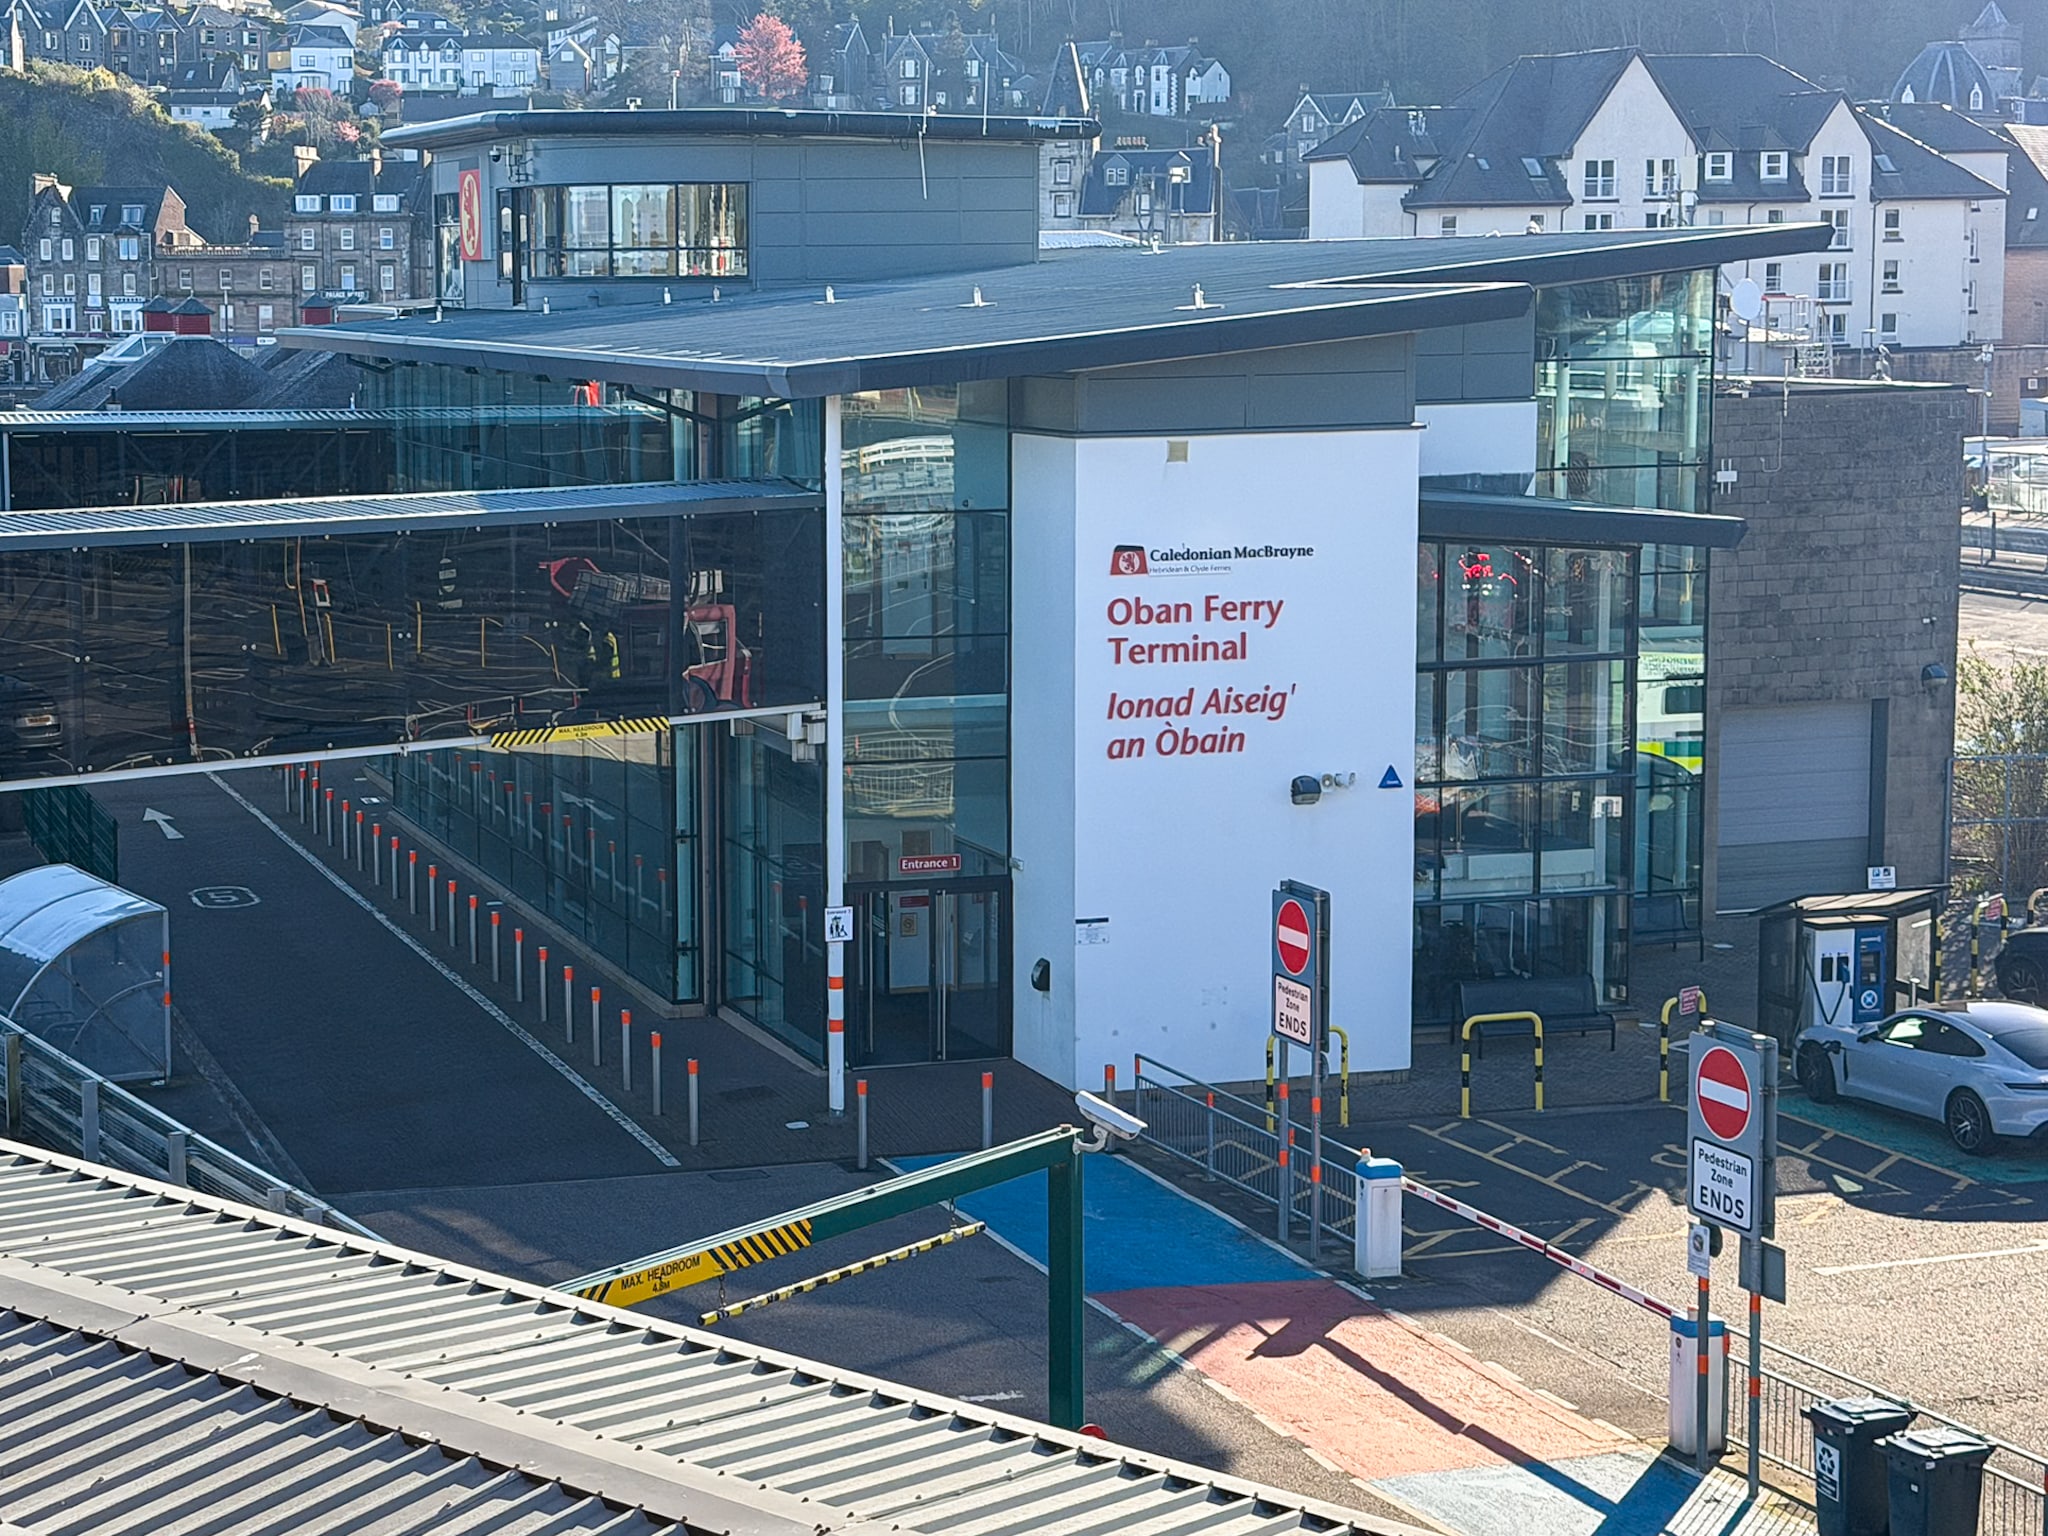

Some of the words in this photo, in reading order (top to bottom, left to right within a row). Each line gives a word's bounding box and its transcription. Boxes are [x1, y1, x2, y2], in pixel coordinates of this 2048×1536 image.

[1150, 548, 1232, 562] Caledonian
[1233, 545, 1314, 560] MacBrayne
[1150, 565, 1183, 574] Hebridean
[1190, 564, 1209, 574] Clyde
[1210, 564, 1232, 572] Ferries
[1107, 596, 1192, 626] Oban
[1204, 595, 1284, 629] Ferry
[1107, 632, 1247, 665] Terminal
[1107, 688, 1195, 720] Ionad
[1107, 737, 1145, 760] an
[1155, 721, 1246, 757] Òbain
[901, 859, 948, 870] Entrance
[952, 857, 957, 867] 1
[207, 890, 239, 903] 5
[1278, 982, 1308, 1002] Pedestrian
[1286, 998, 1300, 1012] Zone
[1279, 1012, 1307, 1037] ENDS
[1698, 1148, 1747, 1177] Pedestrian
[1711, 1169, 1734, 1188] Zone
[1700, 1185, 1744, 1220] ENDS
[620, 1273, 644, 1291] MAX.
[647, 1255, 700, 1282] HEADROOM
